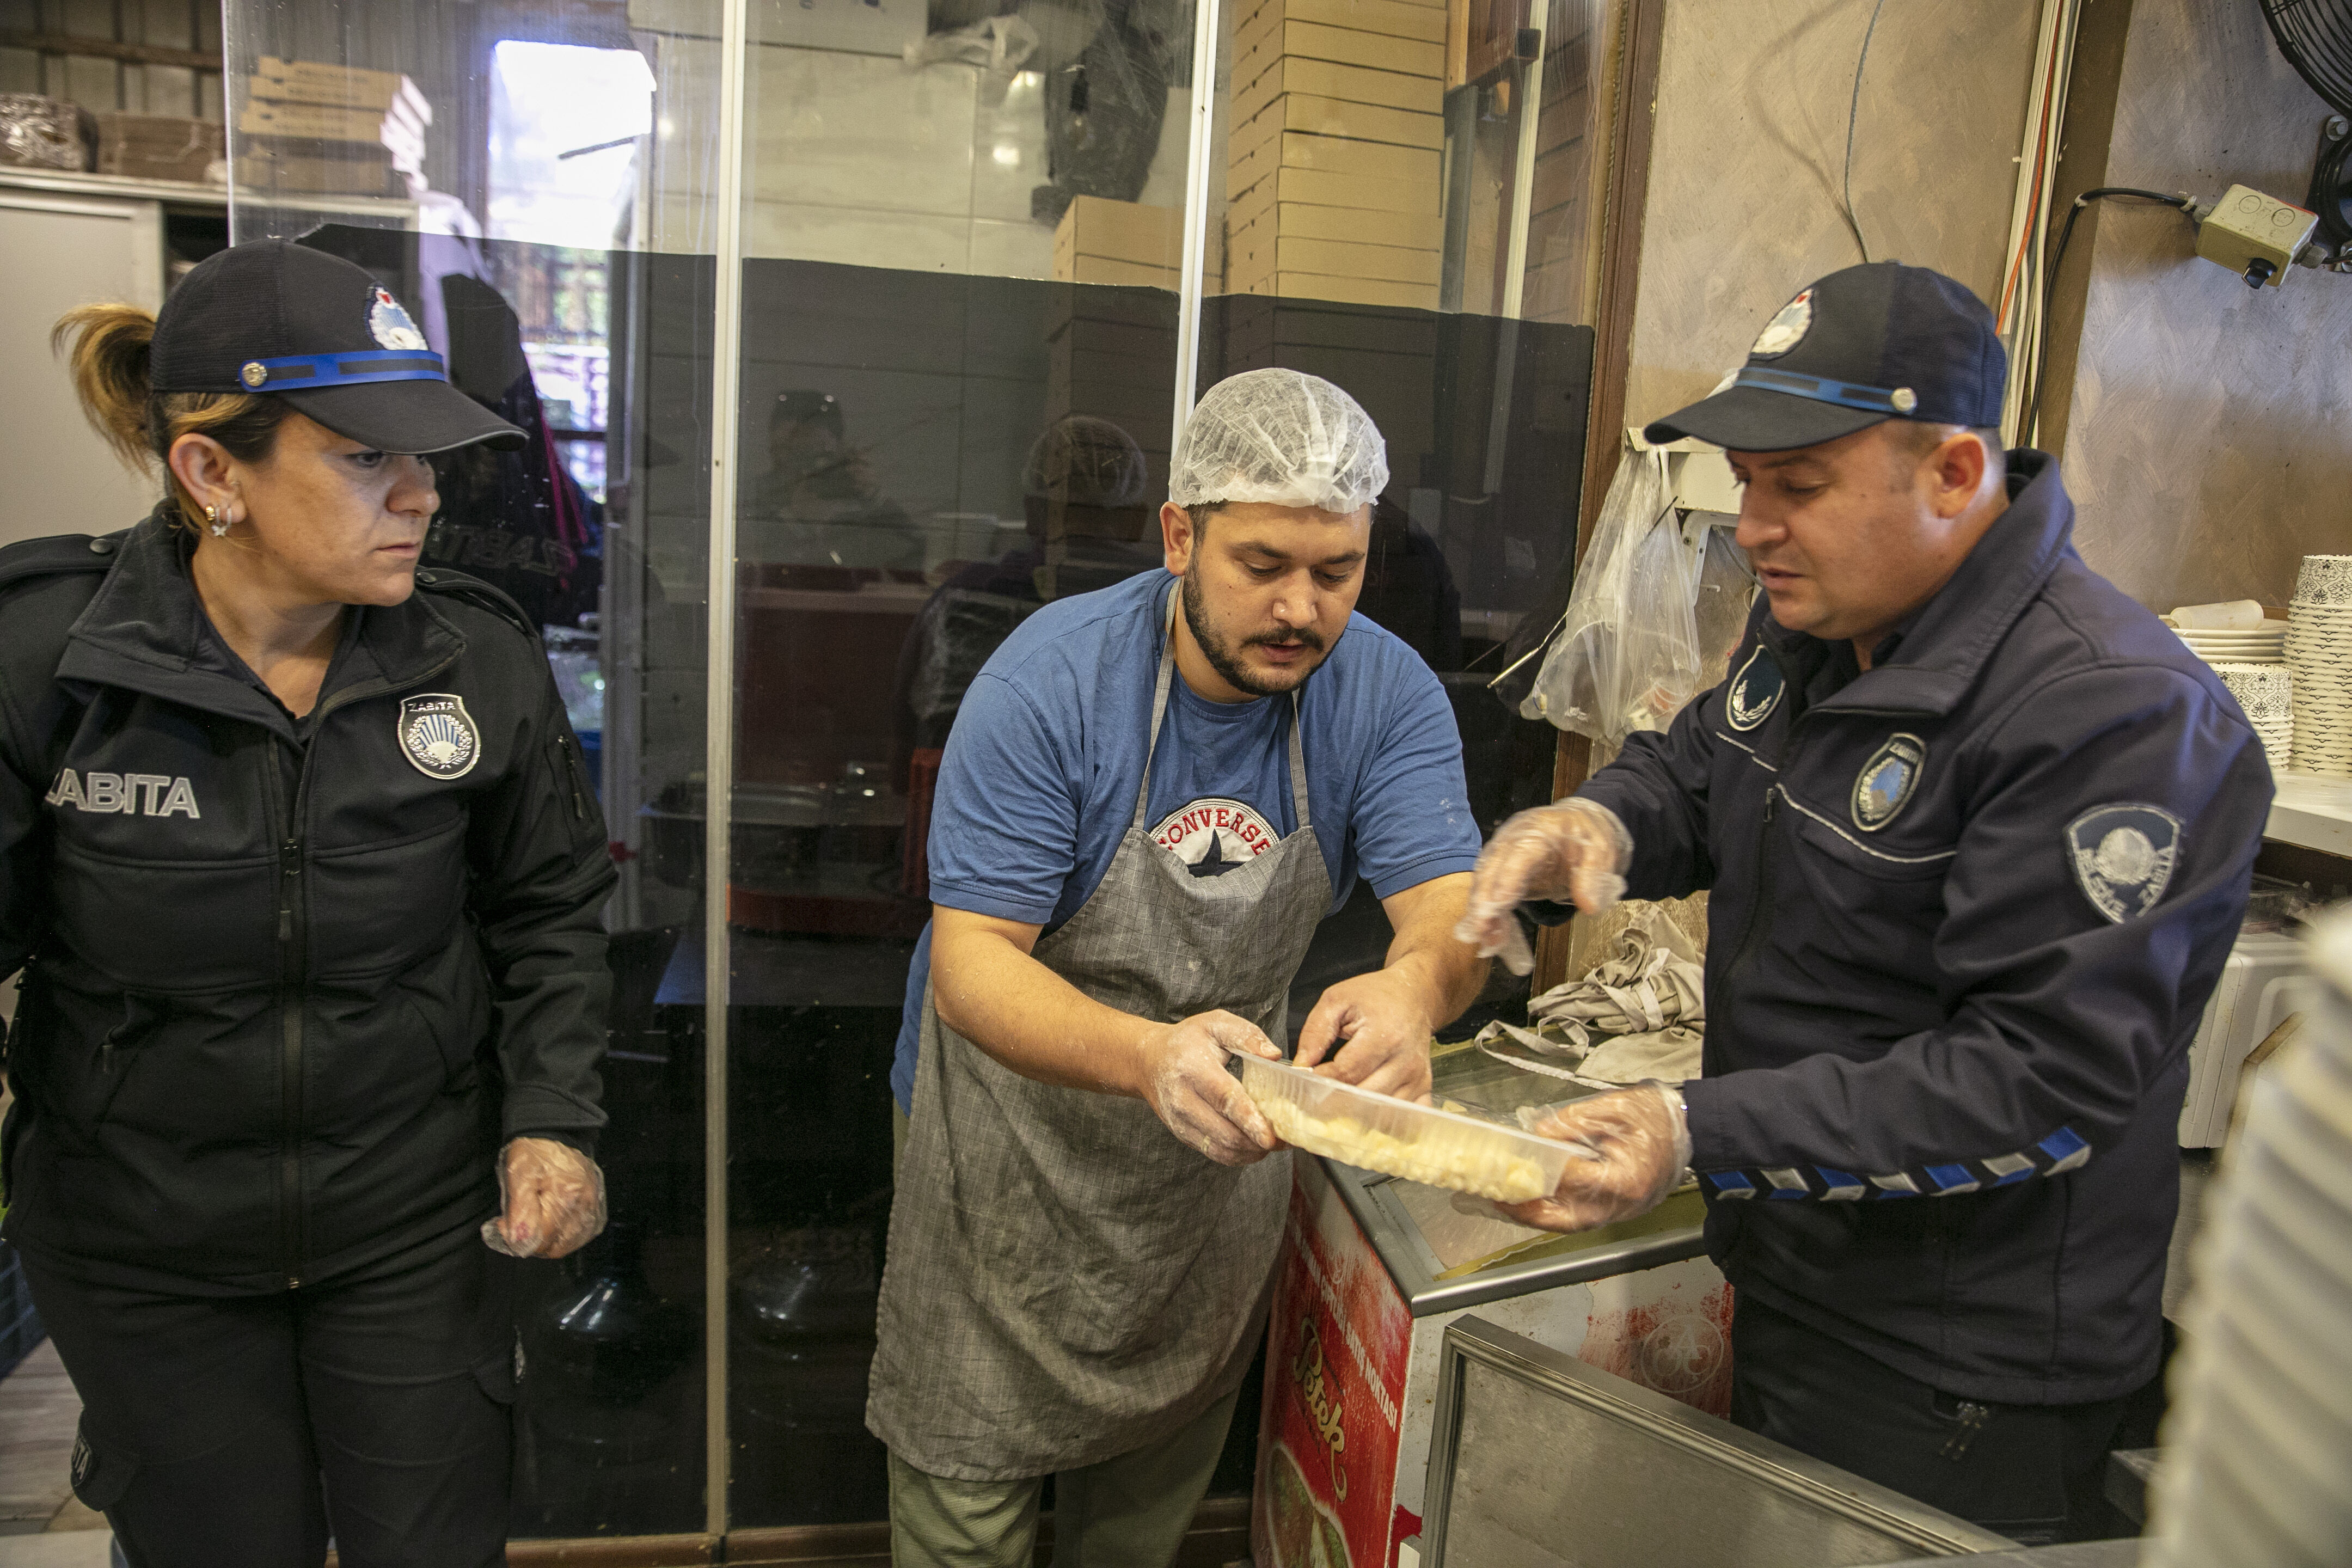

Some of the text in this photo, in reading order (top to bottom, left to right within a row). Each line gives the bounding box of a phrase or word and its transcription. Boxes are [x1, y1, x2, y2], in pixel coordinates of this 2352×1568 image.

[45, 768, 200, 819] ABITA
[1346, 1321, 1365, 1377] SATIŞ
[1365, 1357, 1398, 1433] NOKTASI
